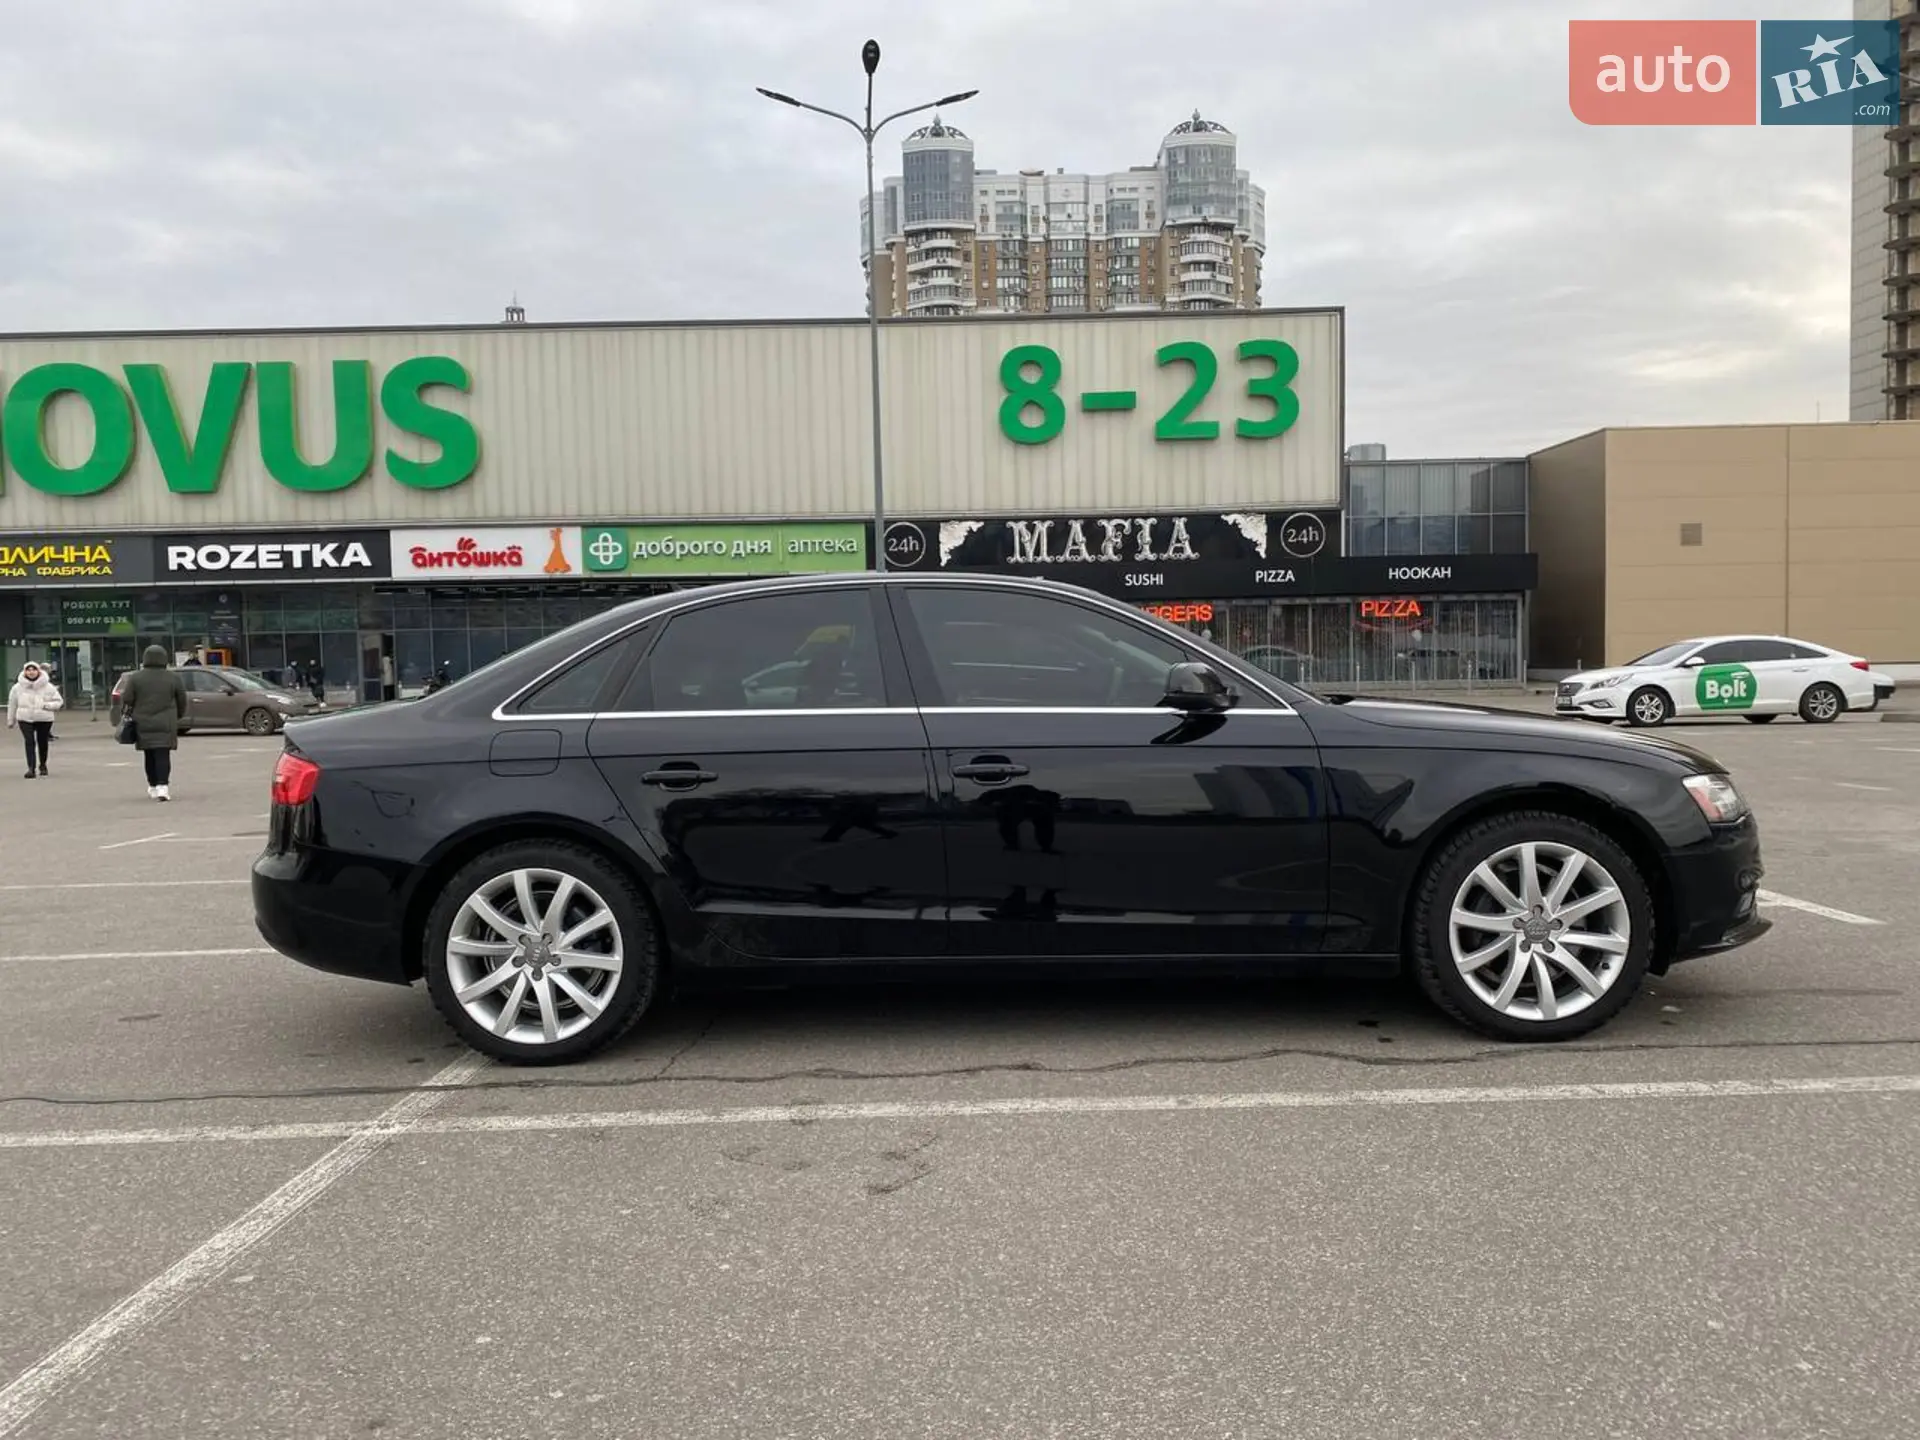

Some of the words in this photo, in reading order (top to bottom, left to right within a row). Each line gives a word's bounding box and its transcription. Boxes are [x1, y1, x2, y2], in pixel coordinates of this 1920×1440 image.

[0, 355, 481, 498] OVUS
[887, 535, 920, 553] 24h
[1006, 516, 1200, 563] MAFIA
[1286, 525, 1320, 545] 24h
[632, 535, 728, 559] доброго
[731, 538, 772, 558] дня
[787, 535, 858, 554] аптека
[167, 542, 372, 571] ROZETKA
[36, 565, 113, 577] ФАБРИКА
[1124, 572, 1164, 587] SUSHI
[1255, 569, 1295, 583] PIZZA
[1388, 565, 1451, 581] HOOKAH
[62, 600, 108, 609] РОБОТА
[110, 599, 131, 609] ТУТ
[1360, 600, 1422, 617] PIZZA
[1704, 678, 1748, 700] Bolt
